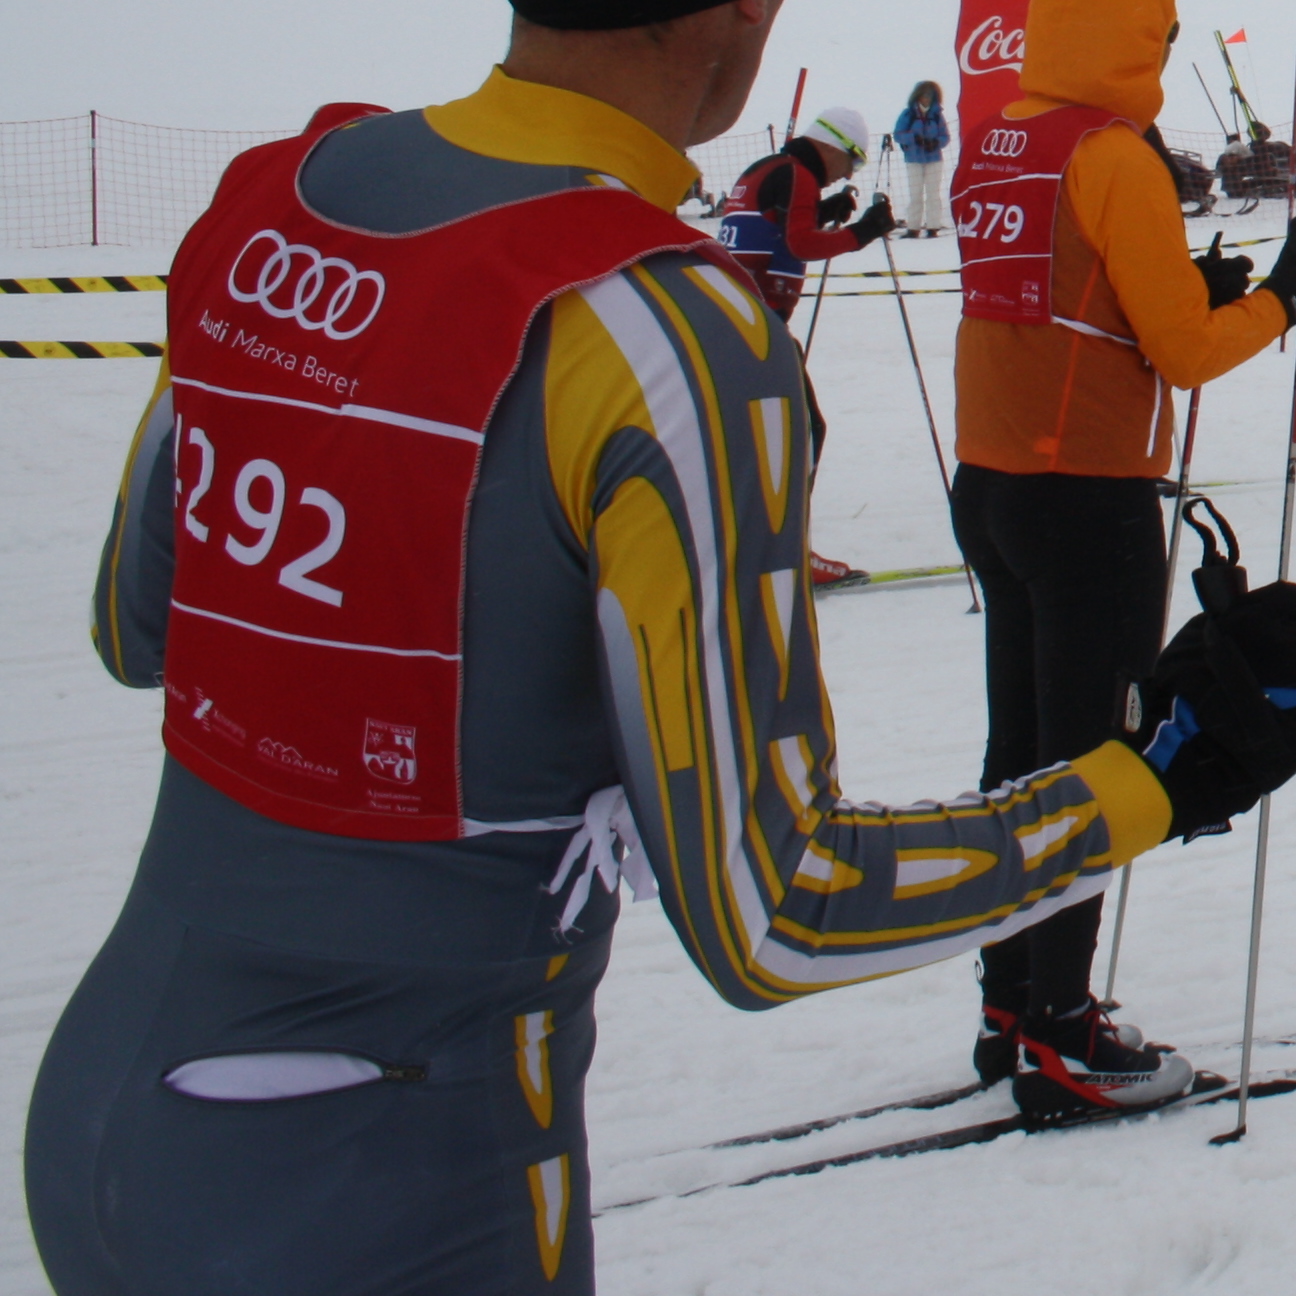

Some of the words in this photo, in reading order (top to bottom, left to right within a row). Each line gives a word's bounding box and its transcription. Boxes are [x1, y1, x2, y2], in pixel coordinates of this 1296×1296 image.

[199, 309, 229, 342] Audi
[231, 329, 297, 370] Marxa
[302, 356, 360, 397] Beret
[175, 413, 346, 606] 292
